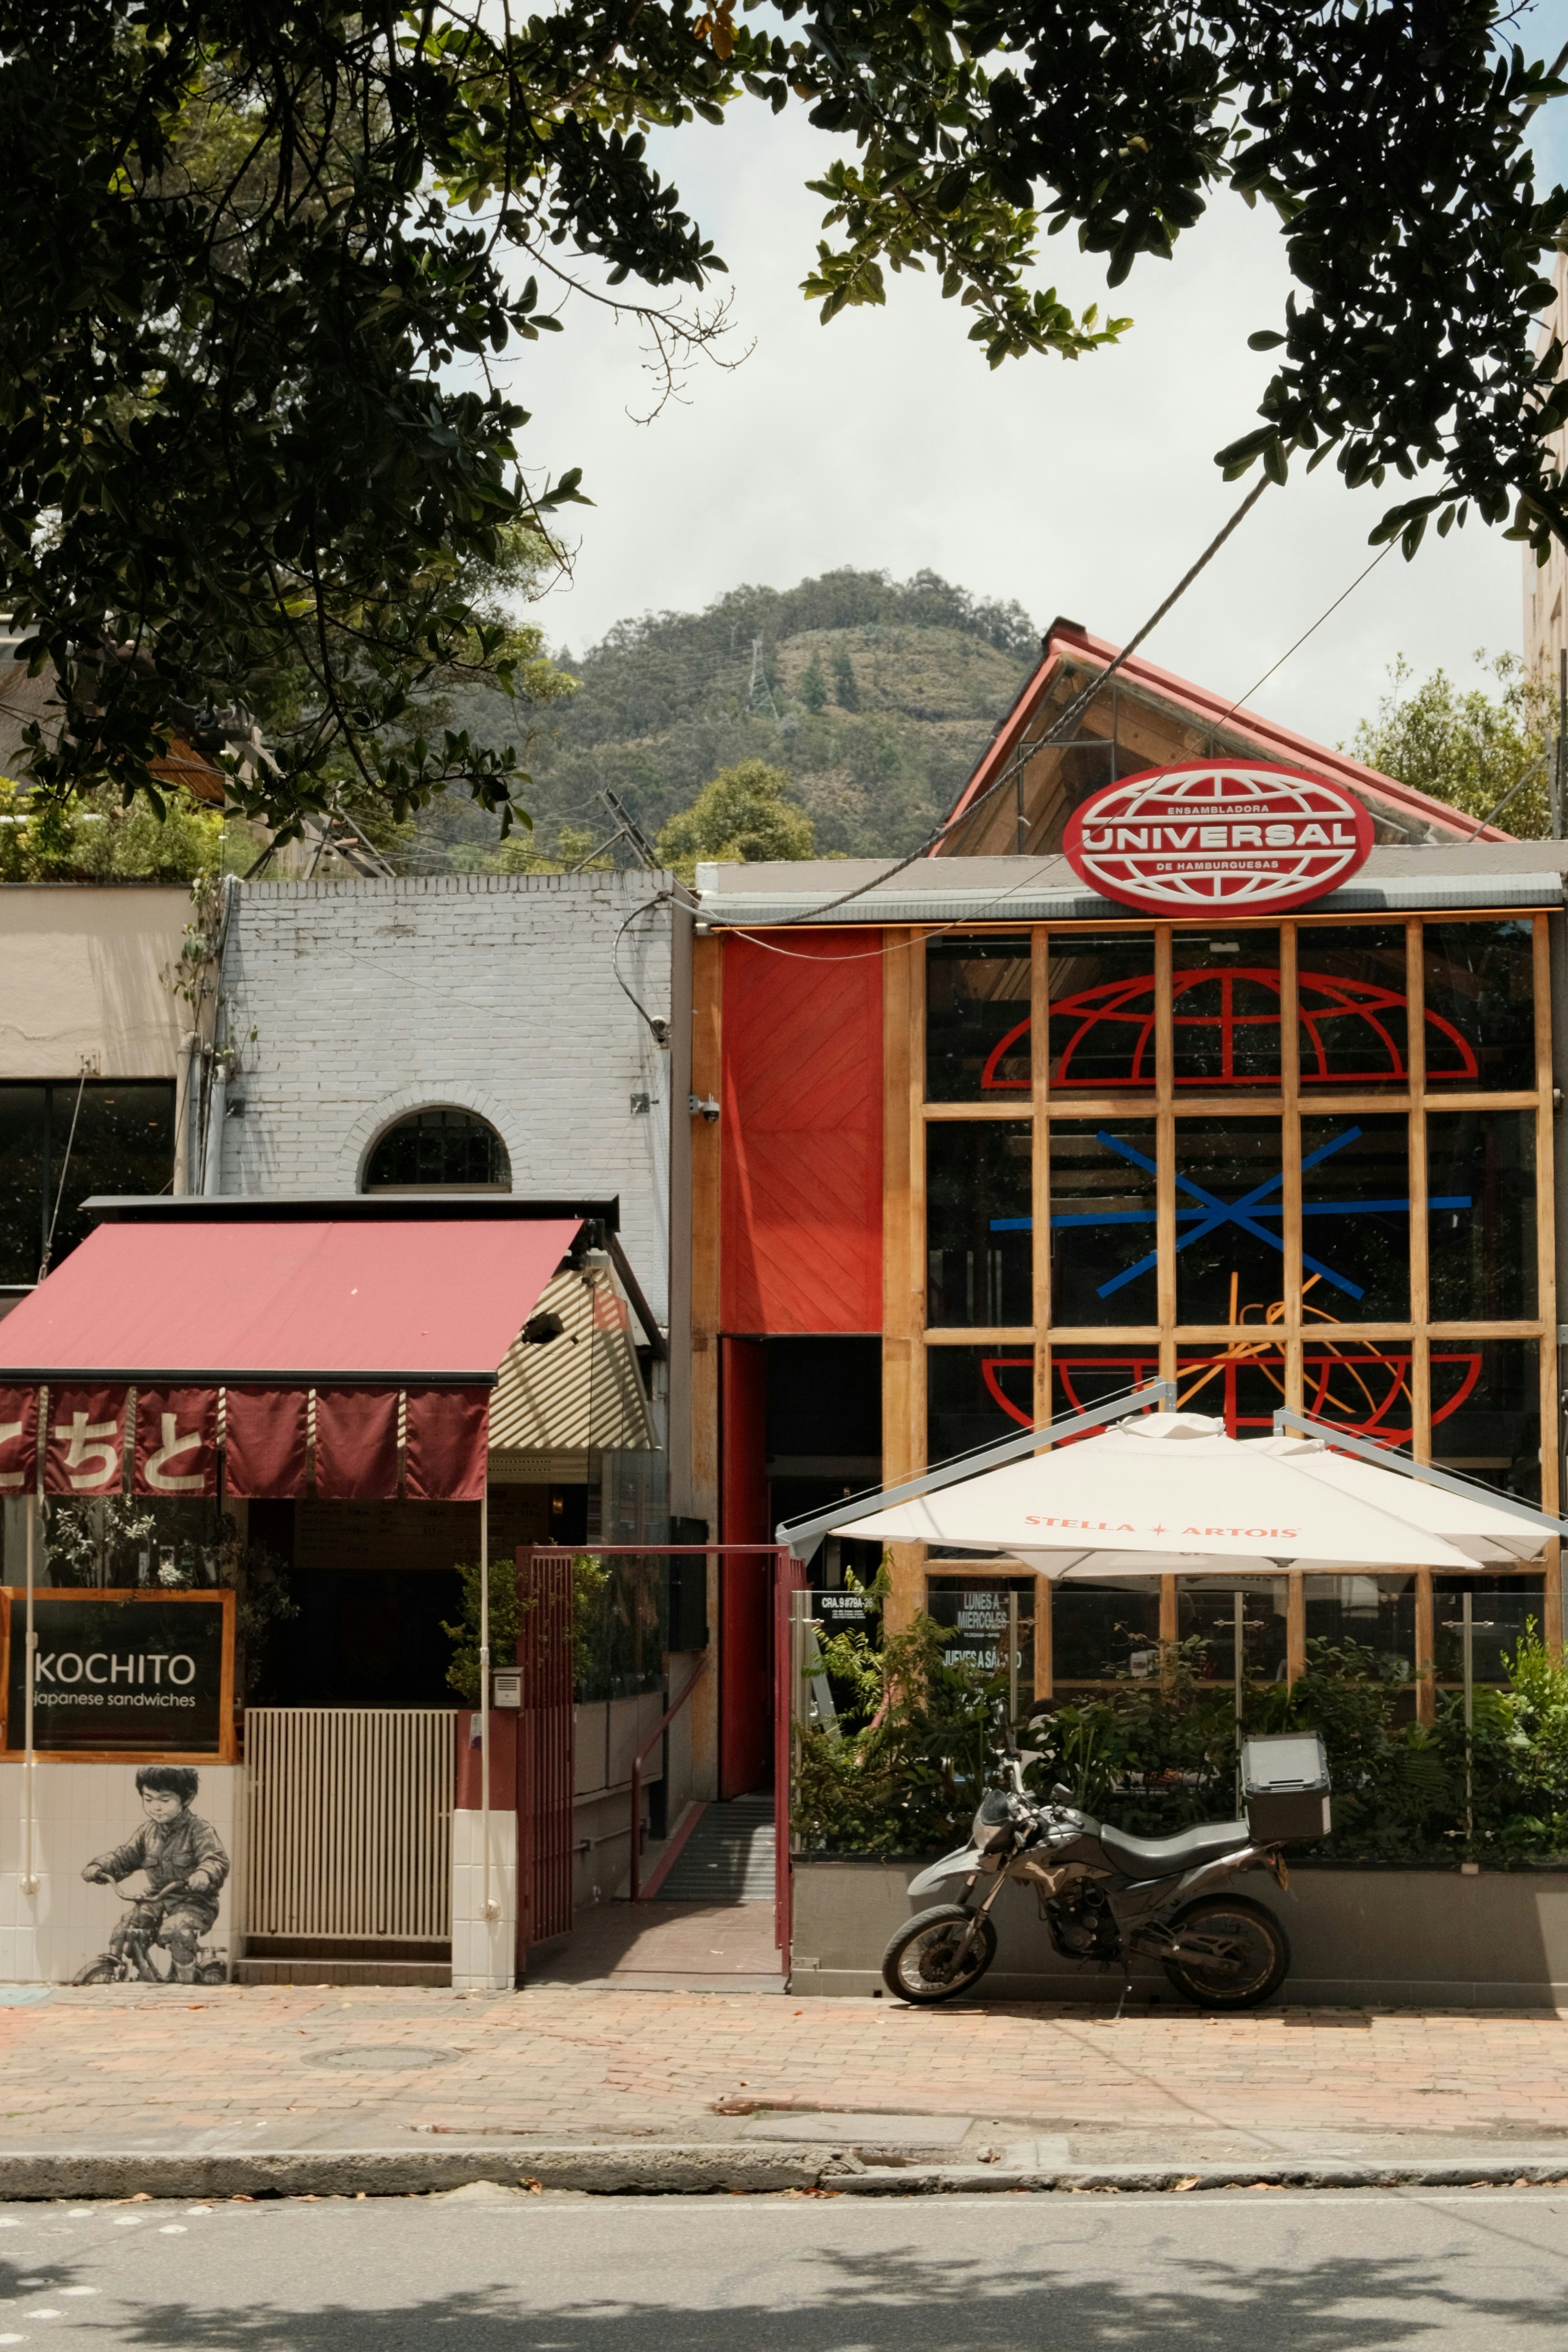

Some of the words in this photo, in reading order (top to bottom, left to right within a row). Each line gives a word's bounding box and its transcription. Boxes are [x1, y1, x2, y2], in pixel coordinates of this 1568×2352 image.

[1168, 805, 1269, 815] ENSAMBLADORA
[1082, 823, 1356, 850] UNIVERSAL
[1177, 860, 1279, 870] HAMBURGUESAS
[1024, 1515, 1137, 1532] STELLA
[1181, 1526, 1298, 1538] ARTOIS
[964, 1593, 992, 1611] LUNES
[993, 1593, 1000, 1610] A
[35, 1652, 196, 1685] KOCHITO
[33, 1690, 104, 1707] japanese
[107, 1692, 196, 1707] sandwiches
